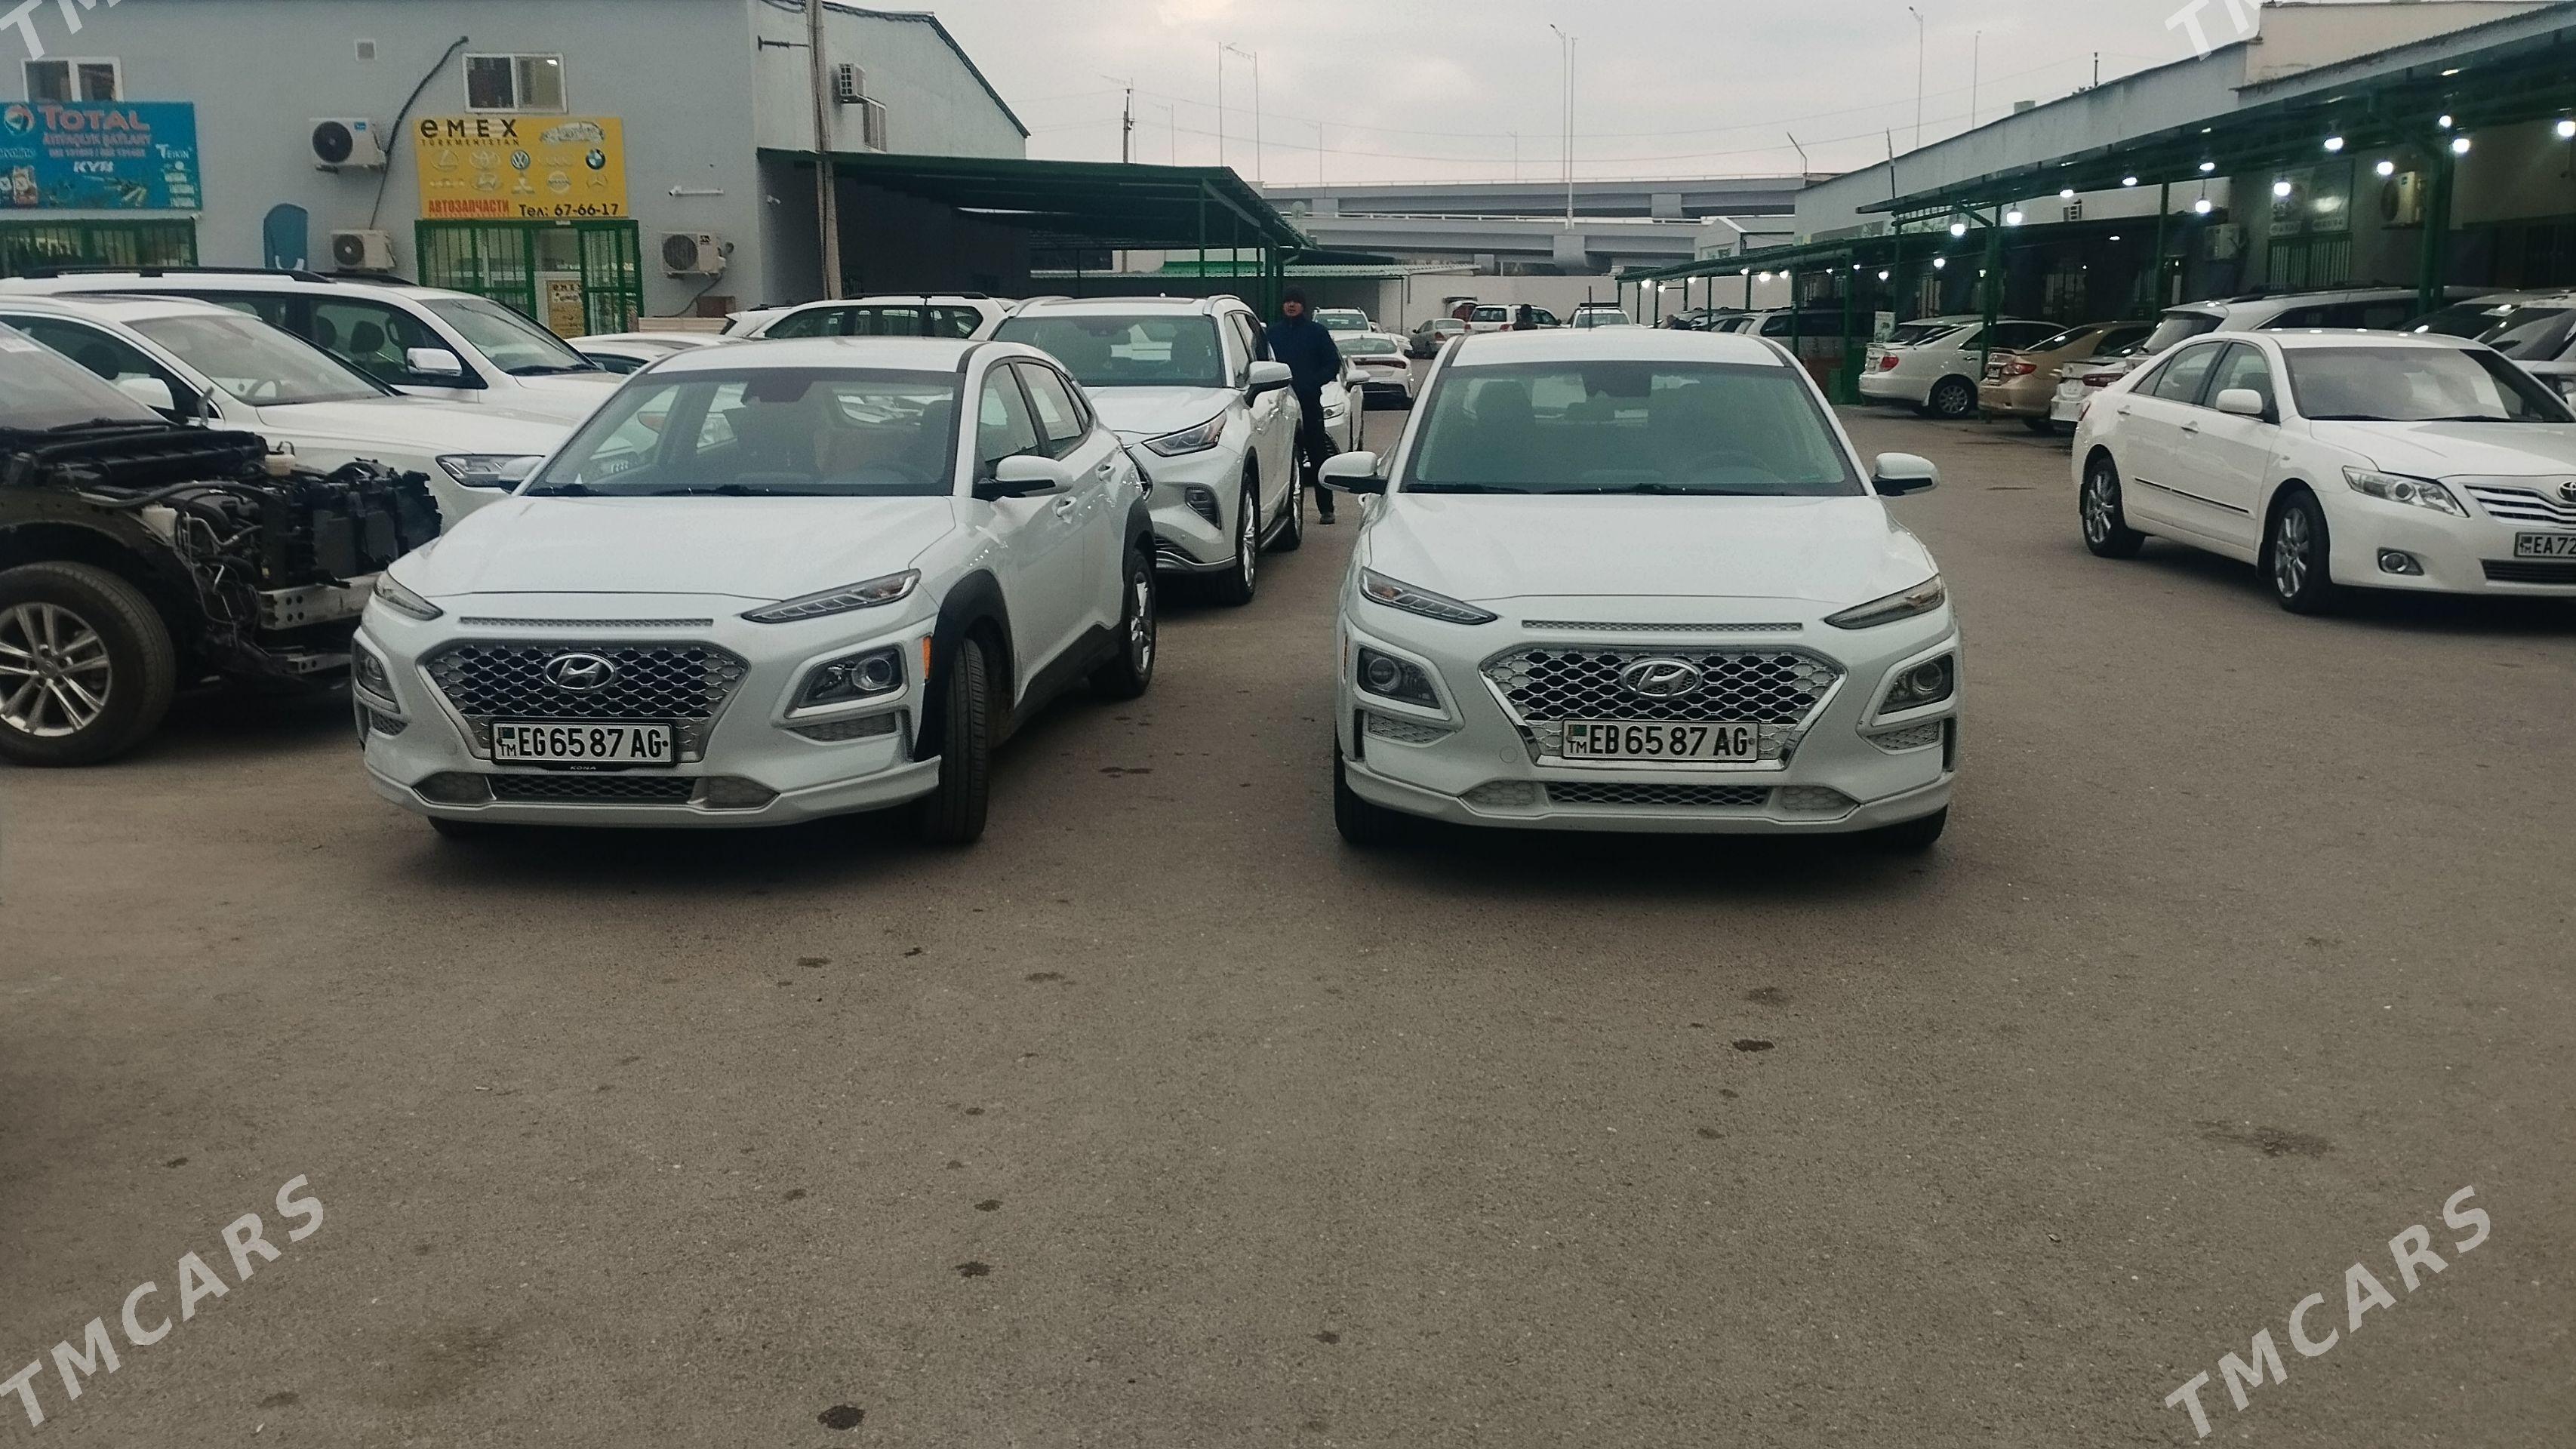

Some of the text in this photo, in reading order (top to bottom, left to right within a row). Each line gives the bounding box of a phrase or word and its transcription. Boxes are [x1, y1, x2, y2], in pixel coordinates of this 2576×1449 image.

[38, 104, 150, 131] TOTAL
[429, 199, 509, 213] АВТОЗАПЧАСТИ
[519, 203, 619, 217] Тел: 67-66-17
[1713, 727, 1748, 755] AG
